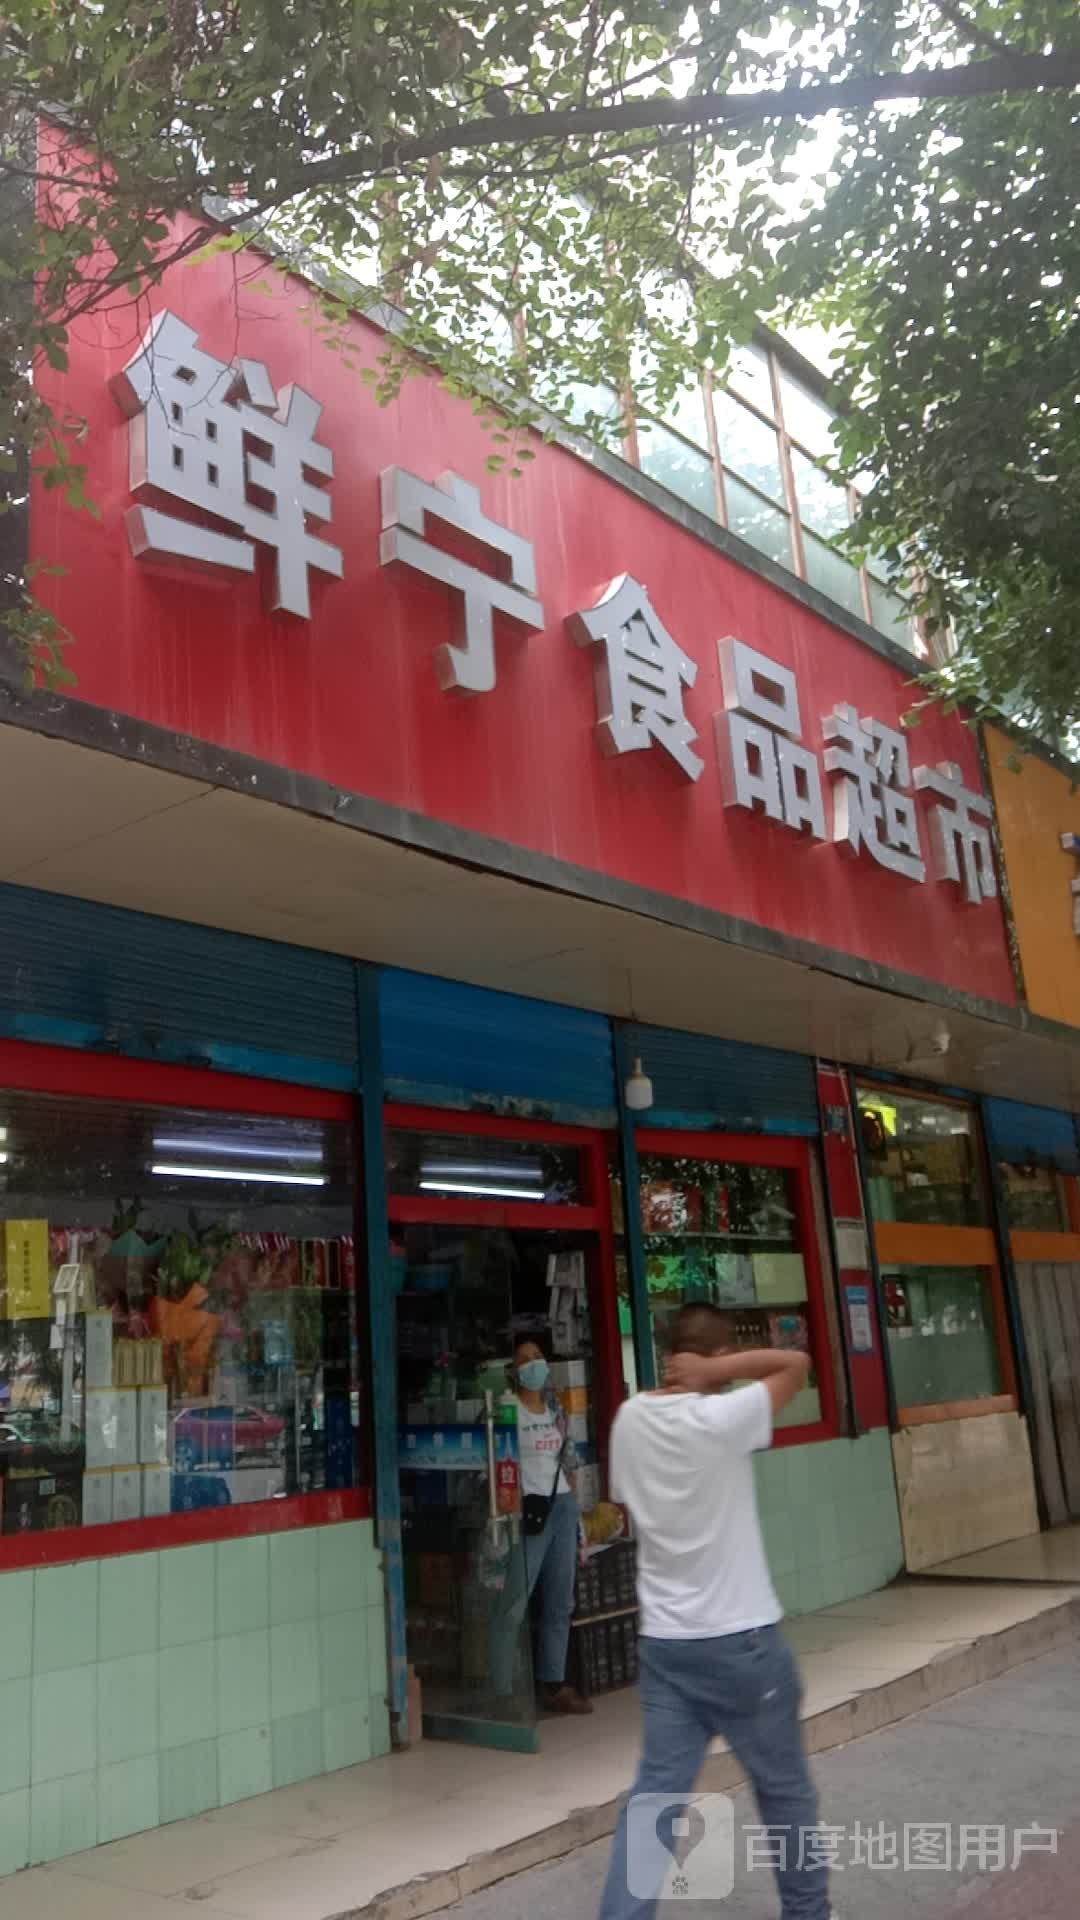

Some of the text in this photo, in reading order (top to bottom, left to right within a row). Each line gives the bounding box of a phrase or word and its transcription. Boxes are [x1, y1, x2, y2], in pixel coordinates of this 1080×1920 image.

[112, 309, 997, 904] 鲜宁食品超市
